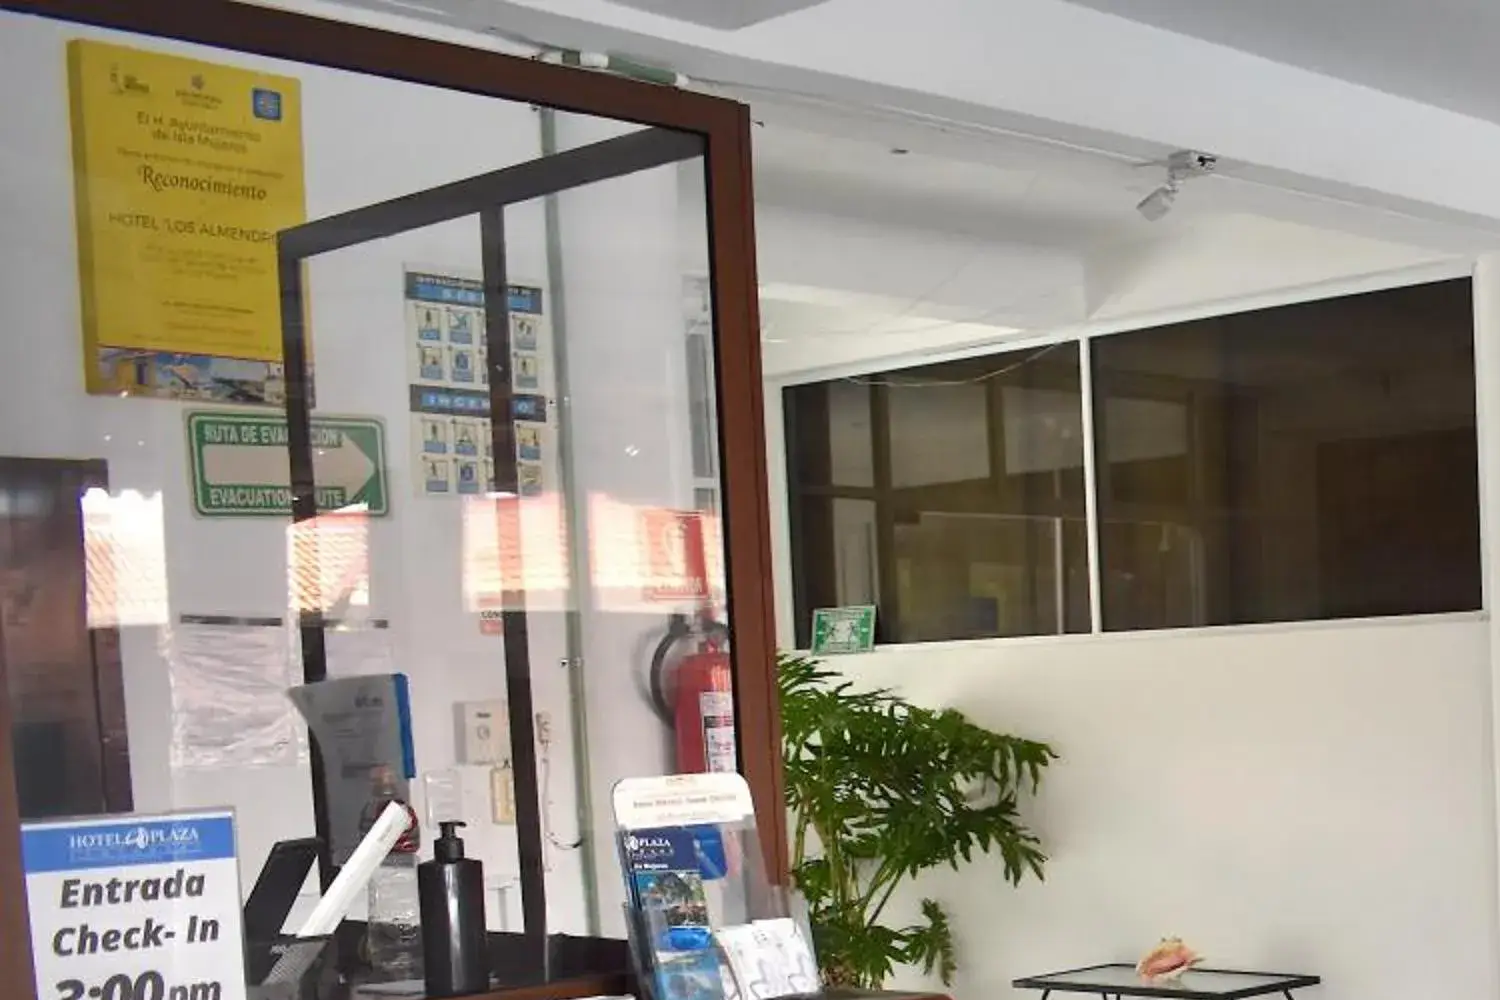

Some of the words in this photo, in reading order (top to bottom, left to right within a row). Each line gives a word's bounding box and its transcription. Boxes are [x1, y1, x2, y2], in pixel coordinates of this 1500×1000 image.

[138, 163, 267, 200] Reconocimiento
[108, 211, 158, 231] HOTEL
[204, 424, 238, 442] RUTA
[260, 425, 339, 446] EVACION
[69, 832, 122, 849] HOTEL
[151, 827, 199, 843] PLAZA
[60, 869, 206, 909] Entrada
[186, 915, 220, 944] In
